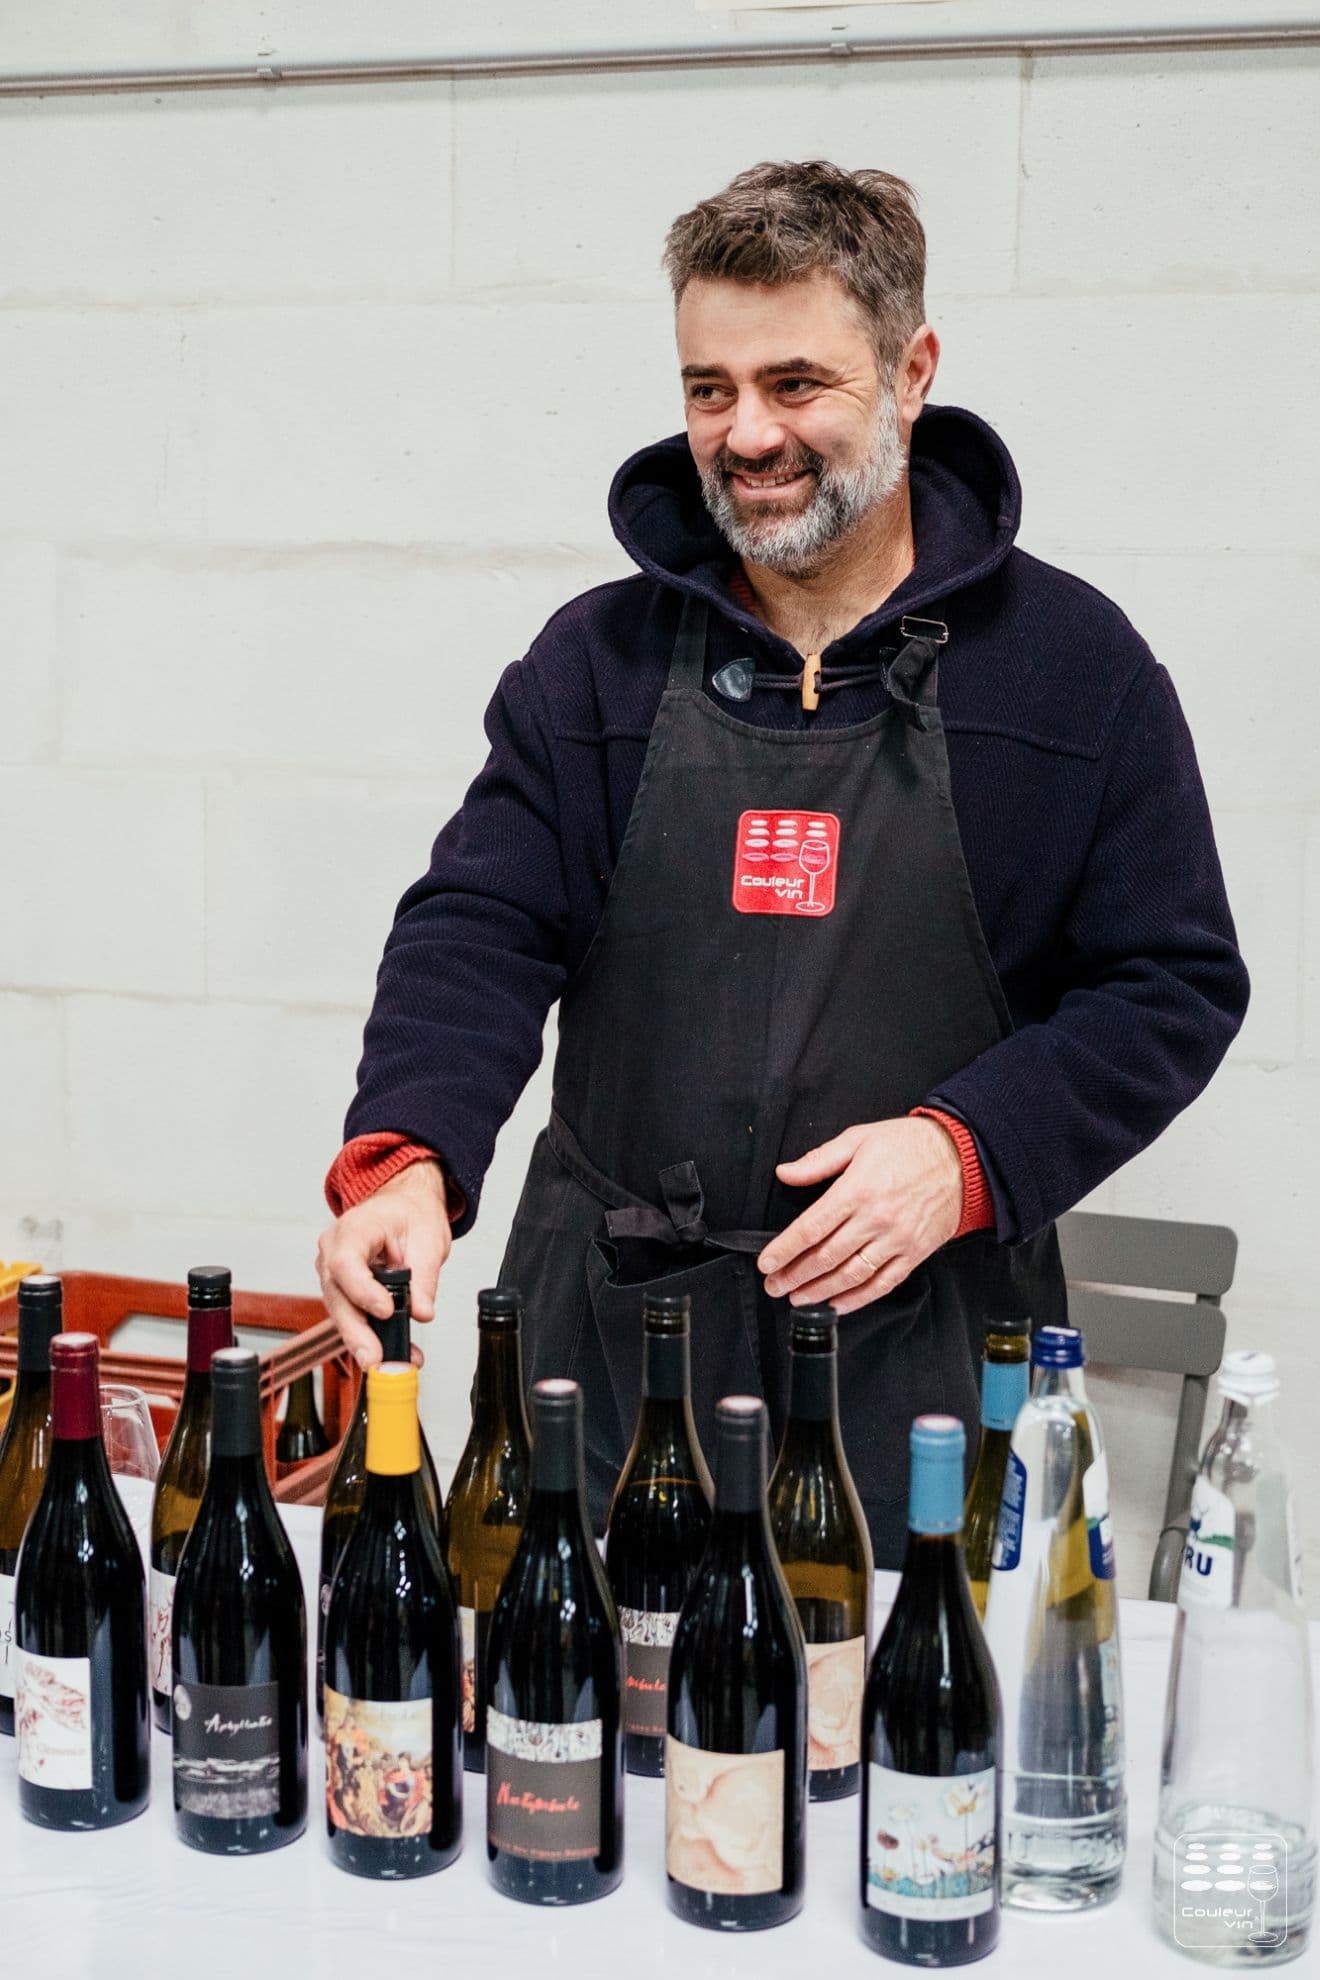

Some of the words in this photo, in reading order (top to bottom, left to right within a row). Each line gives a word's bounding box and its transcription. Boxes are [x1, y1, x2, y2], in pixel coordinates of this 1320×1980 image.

[741, 875, 804, 887] Couleur
[775, 889, 803, 899] vin
[1184, 1545, 1213, 1577] RU
